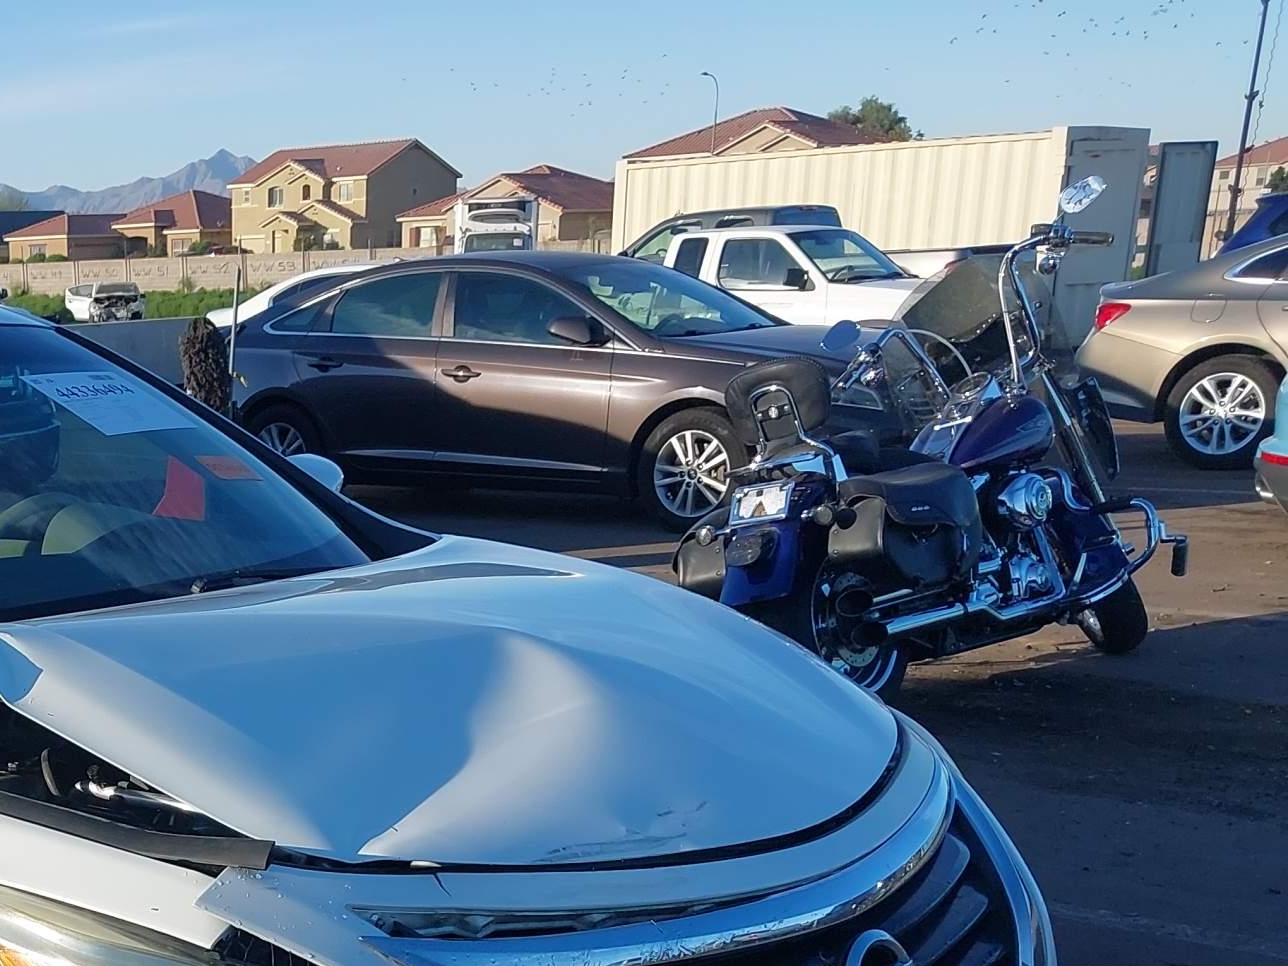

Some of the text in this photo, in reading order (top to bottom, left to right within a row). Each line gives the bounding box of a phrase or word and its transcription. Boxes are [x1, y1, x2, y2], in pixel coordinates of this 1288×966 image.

[156, 265, 169, 278] 51
[277, 261, 296, 273] 53
[55, 384, 135, 399] 44336494
